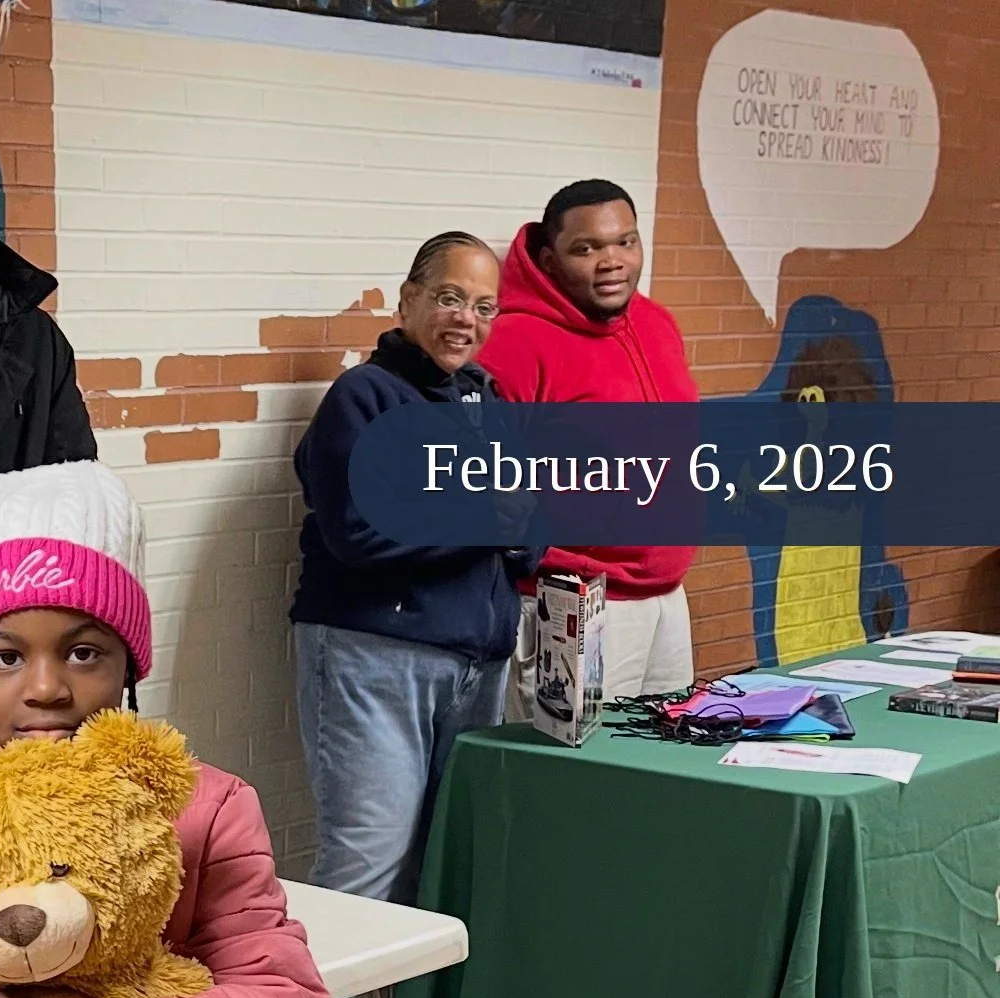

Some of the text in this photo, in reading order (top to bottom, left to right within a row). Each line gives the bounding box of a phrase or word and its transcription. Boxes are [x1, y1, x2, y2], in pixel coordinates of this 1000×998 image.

[737, 67, 918, 111] OPEN YOUR HEART AND
[732, 99, 800, 129] CONNECT
[811, 106, 845, 132] YOUR
[898, 114, 913, 138] TO
[757, 130, 890, 165] SPREAD KINDNESS!
